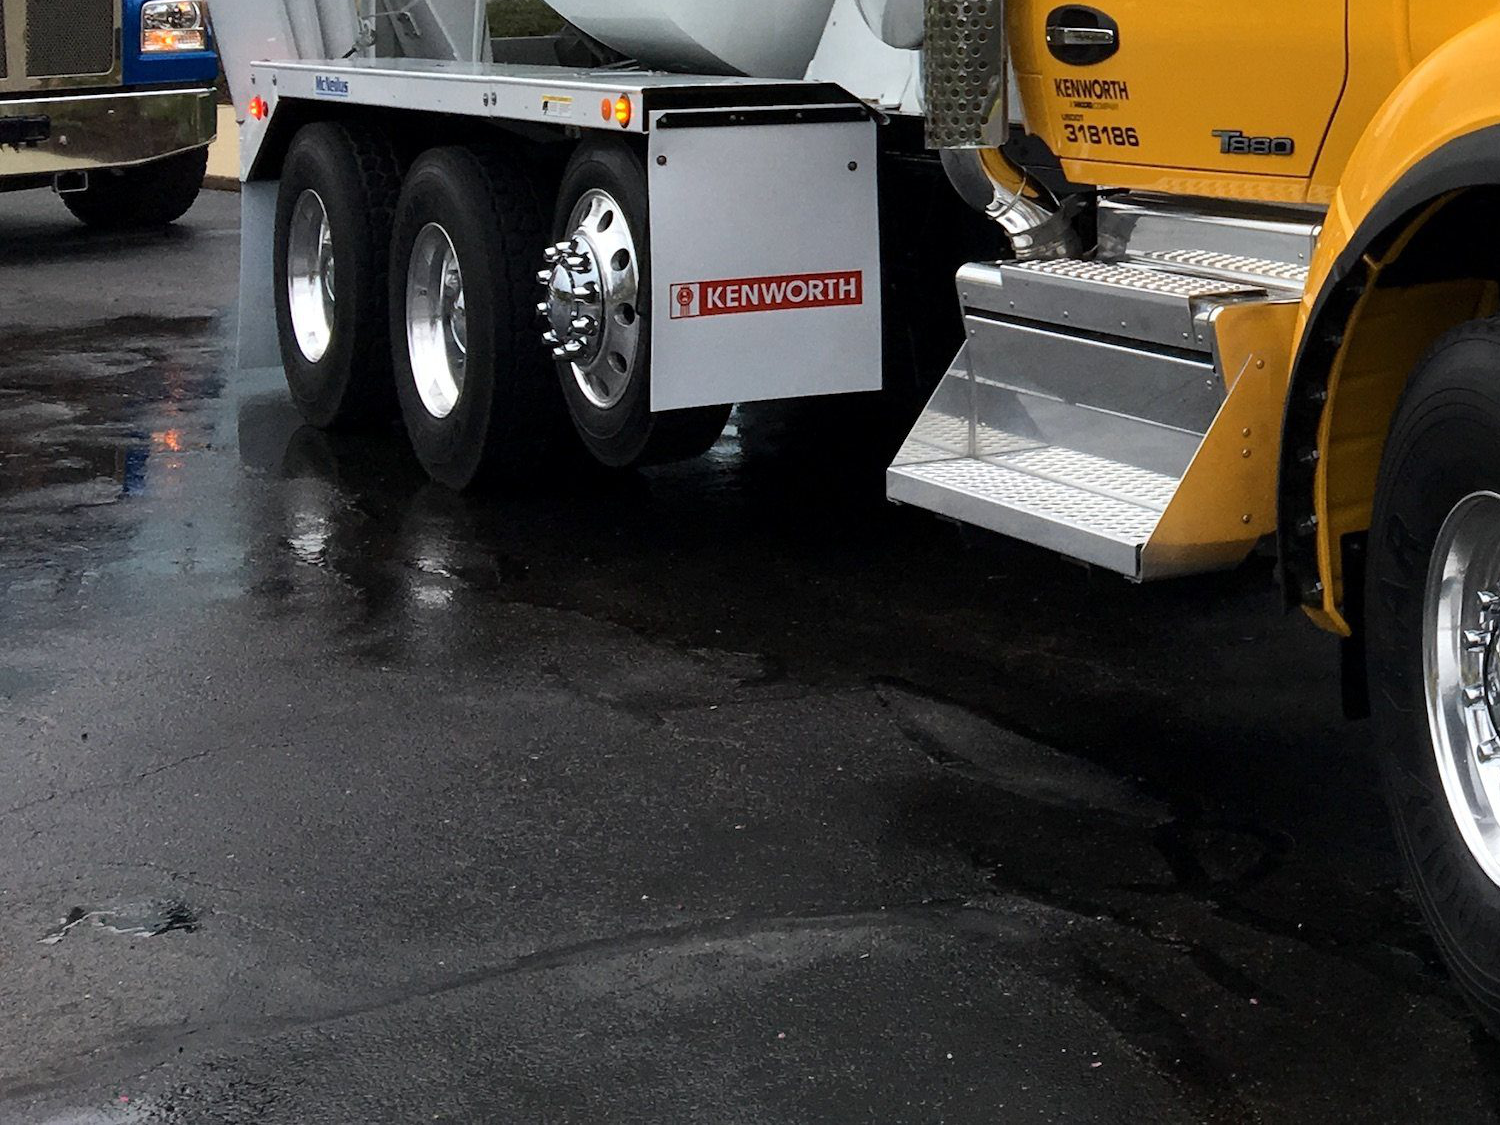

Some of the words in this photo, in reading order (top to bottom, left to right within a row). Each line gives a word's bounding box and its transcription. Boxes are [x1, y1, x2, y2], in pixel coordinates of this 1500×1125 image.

[1054, 78, 1129, 100] KENWORTH
[1063, 123, 1139, 146] 318186
[1211, 129, 1295, 155] T880
[707, 277, 856, 309] KENWORTH
